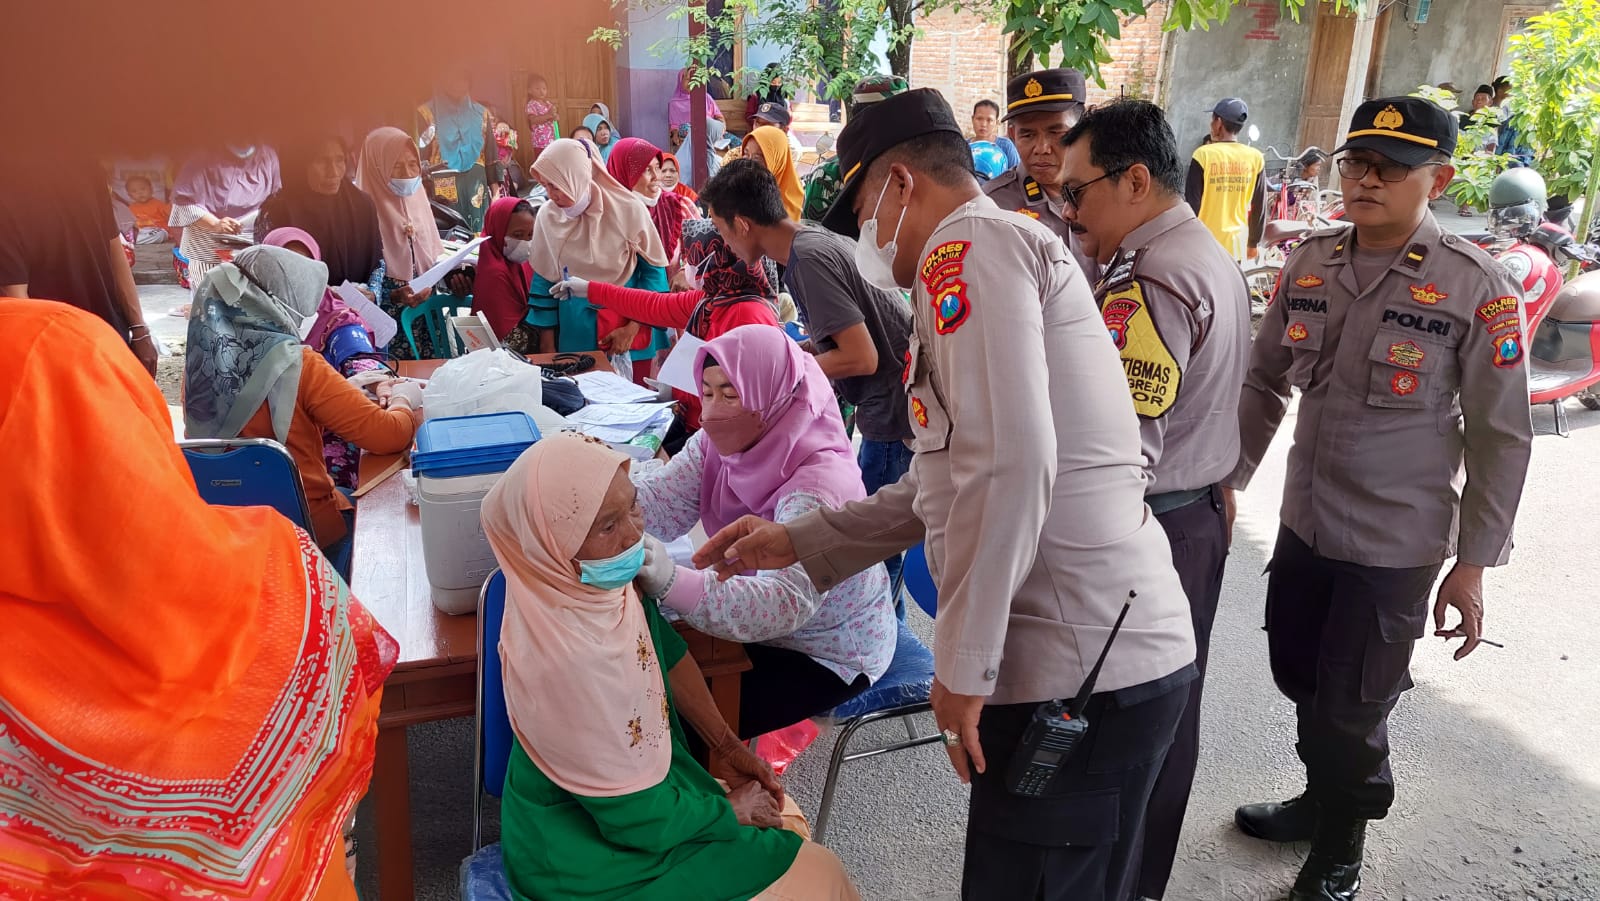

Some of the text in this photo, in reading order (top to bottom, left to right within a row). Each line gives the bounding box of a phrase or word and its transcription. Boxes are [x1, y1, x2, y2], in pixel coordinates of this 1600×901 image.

[922, 243, 964, 276] POLRES
[925, 251, 961, 279] NGANJUK
[1480, 297, 1517, 316] POLRES
[1382, 308, 1452, 337] POLRI
